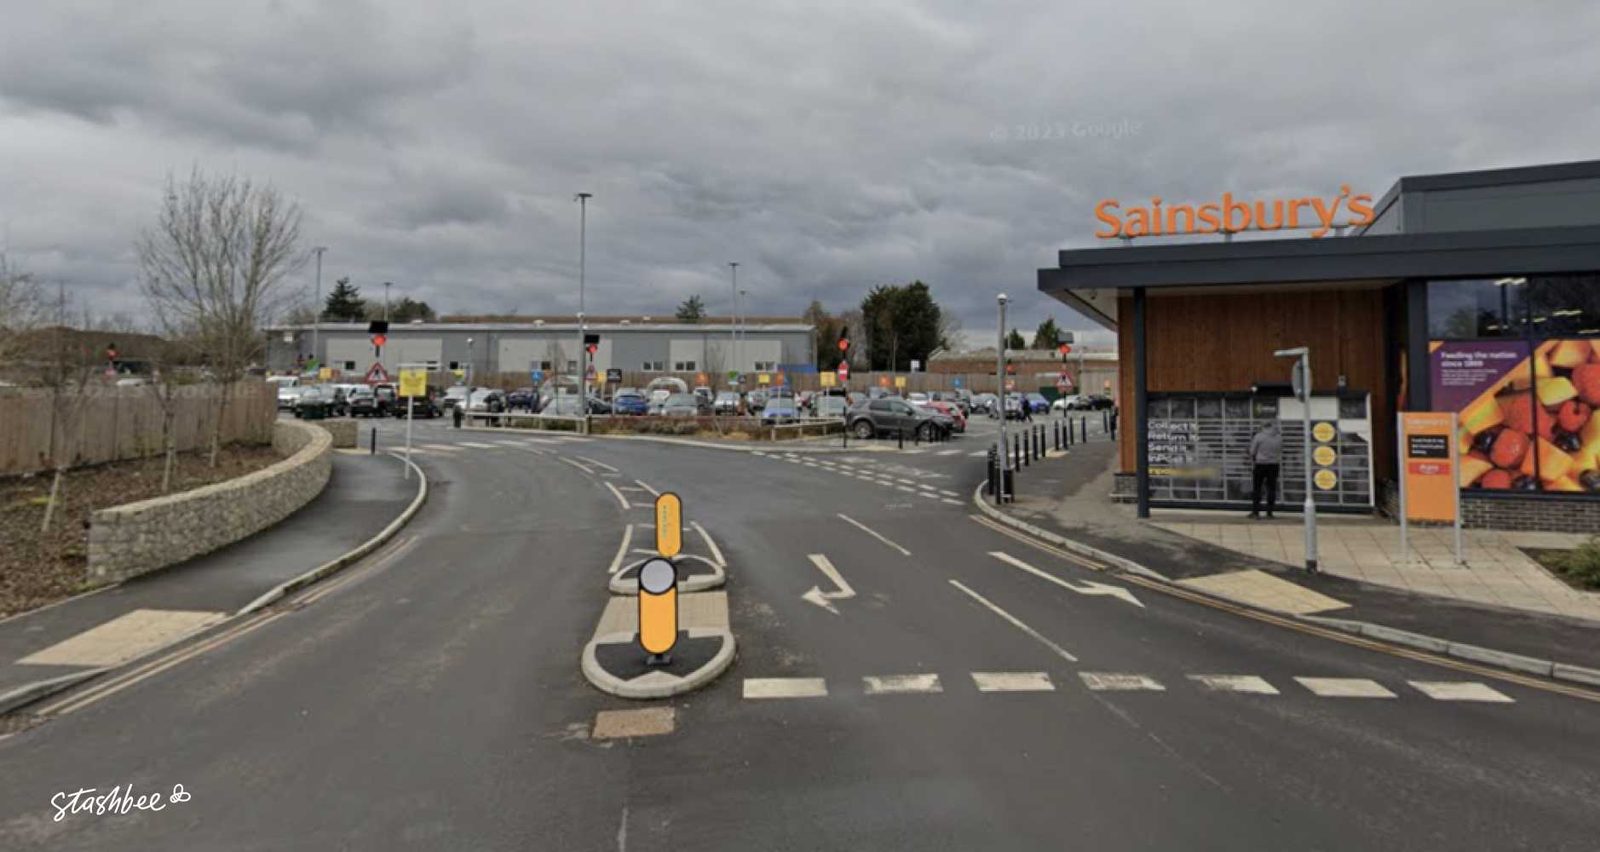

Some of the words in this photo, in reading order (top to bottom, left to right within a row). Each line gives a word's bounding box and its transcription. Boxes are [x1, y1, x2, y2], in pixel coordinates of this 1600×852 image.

[1095, 184, 1376, 239] Sainsbury's
[1441, 351, 1473, 361] Feeding
[1474, 351, 1488, 359] the
[1441, 360, 1463, 368] since
[1147, 420, 1188, 431] Collect
[1147, 431, 1187, 443] Return
[1147, 441, 1179, 453] Send
